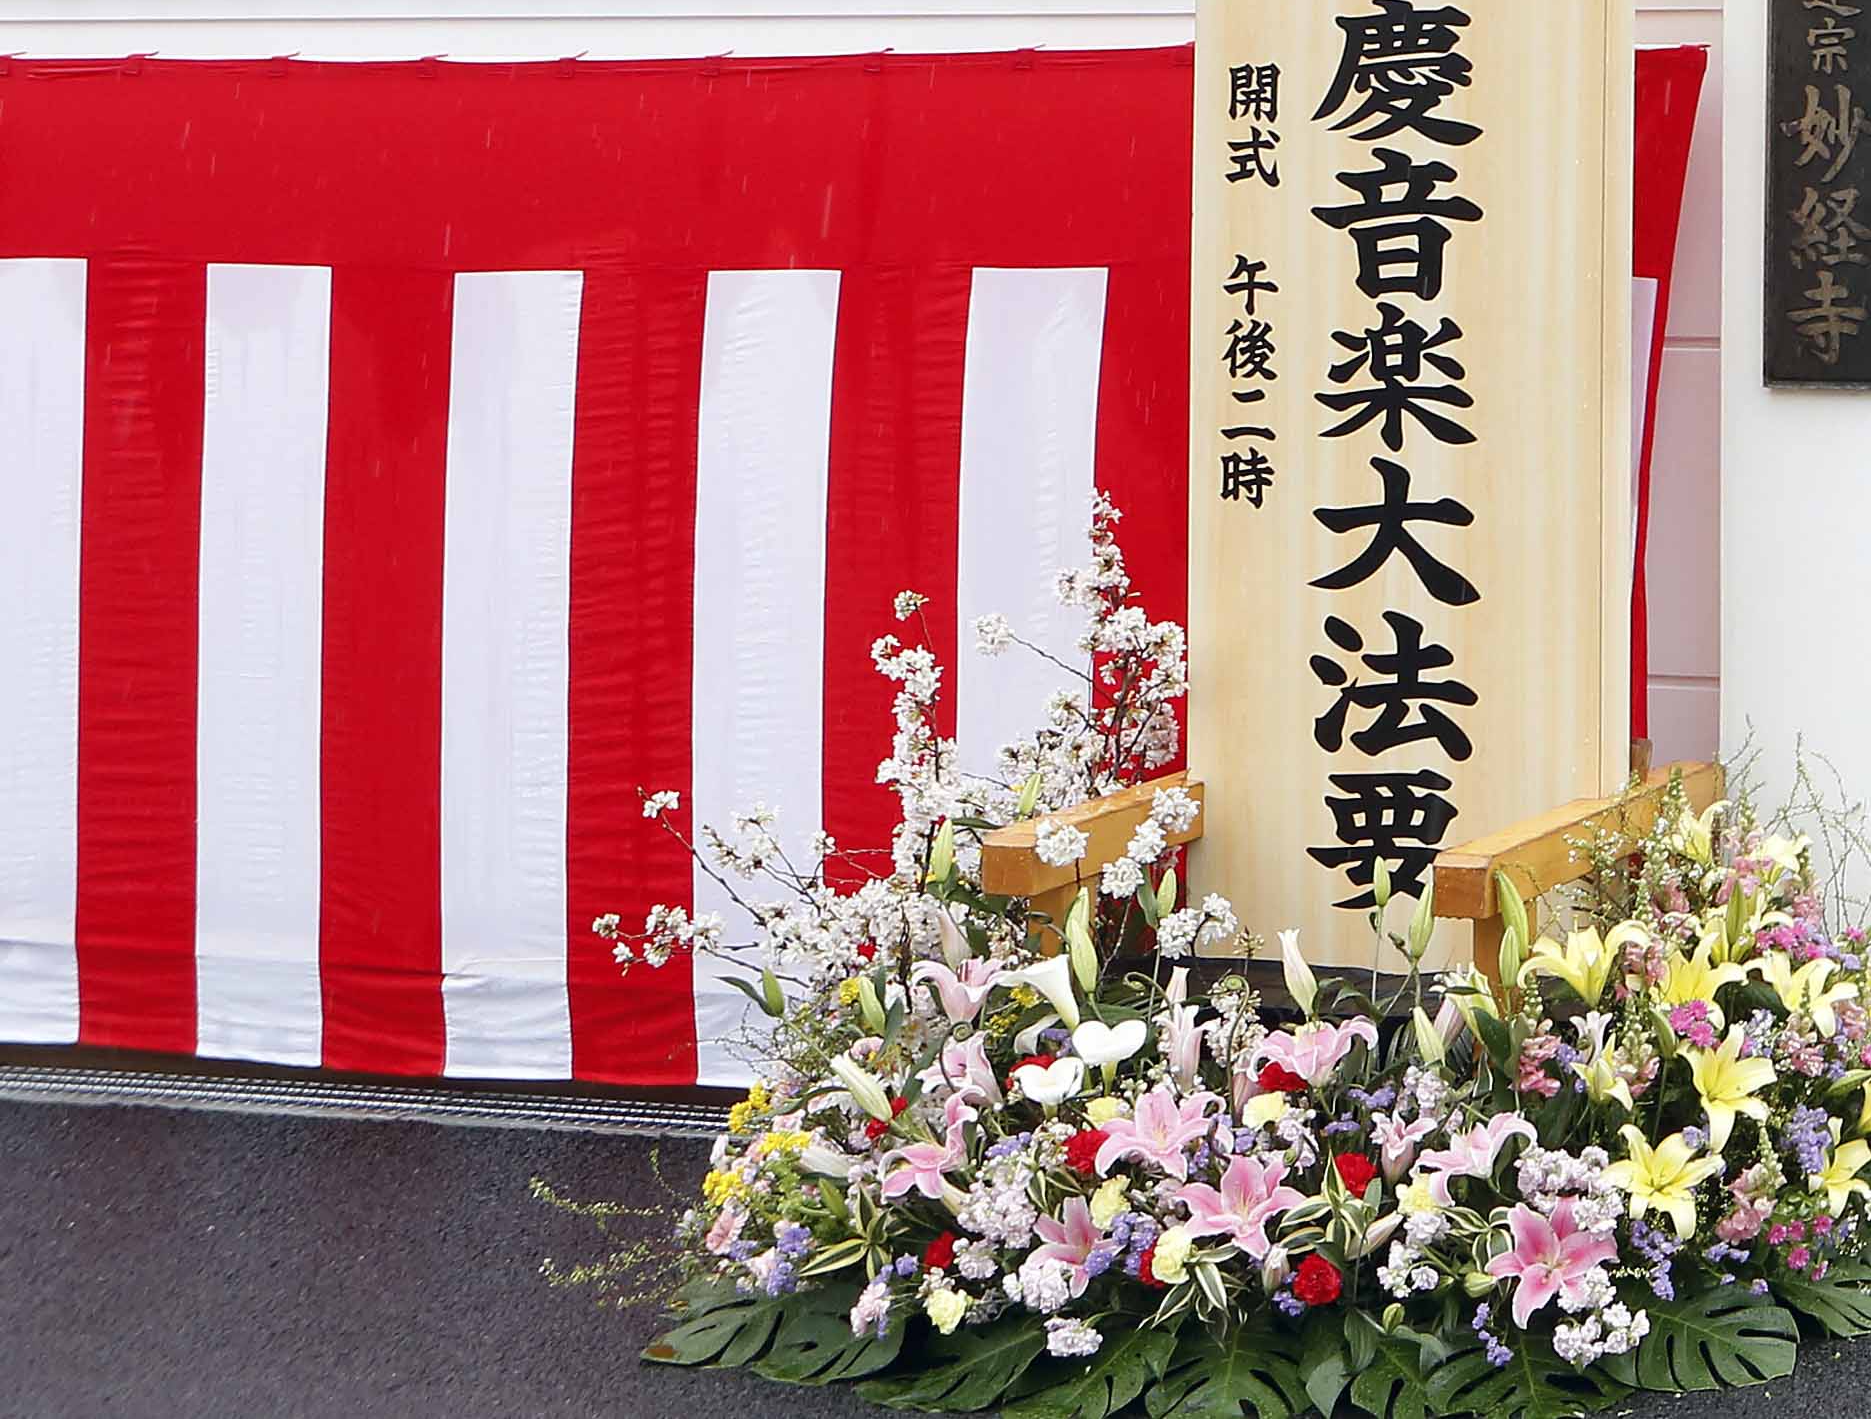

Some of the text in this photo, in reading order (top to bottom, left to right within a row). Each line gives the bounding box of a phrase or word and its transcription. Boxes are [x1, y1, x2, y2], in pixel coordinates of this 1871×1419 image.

[1220, 63, 1281, 509] 開式 午後二時
